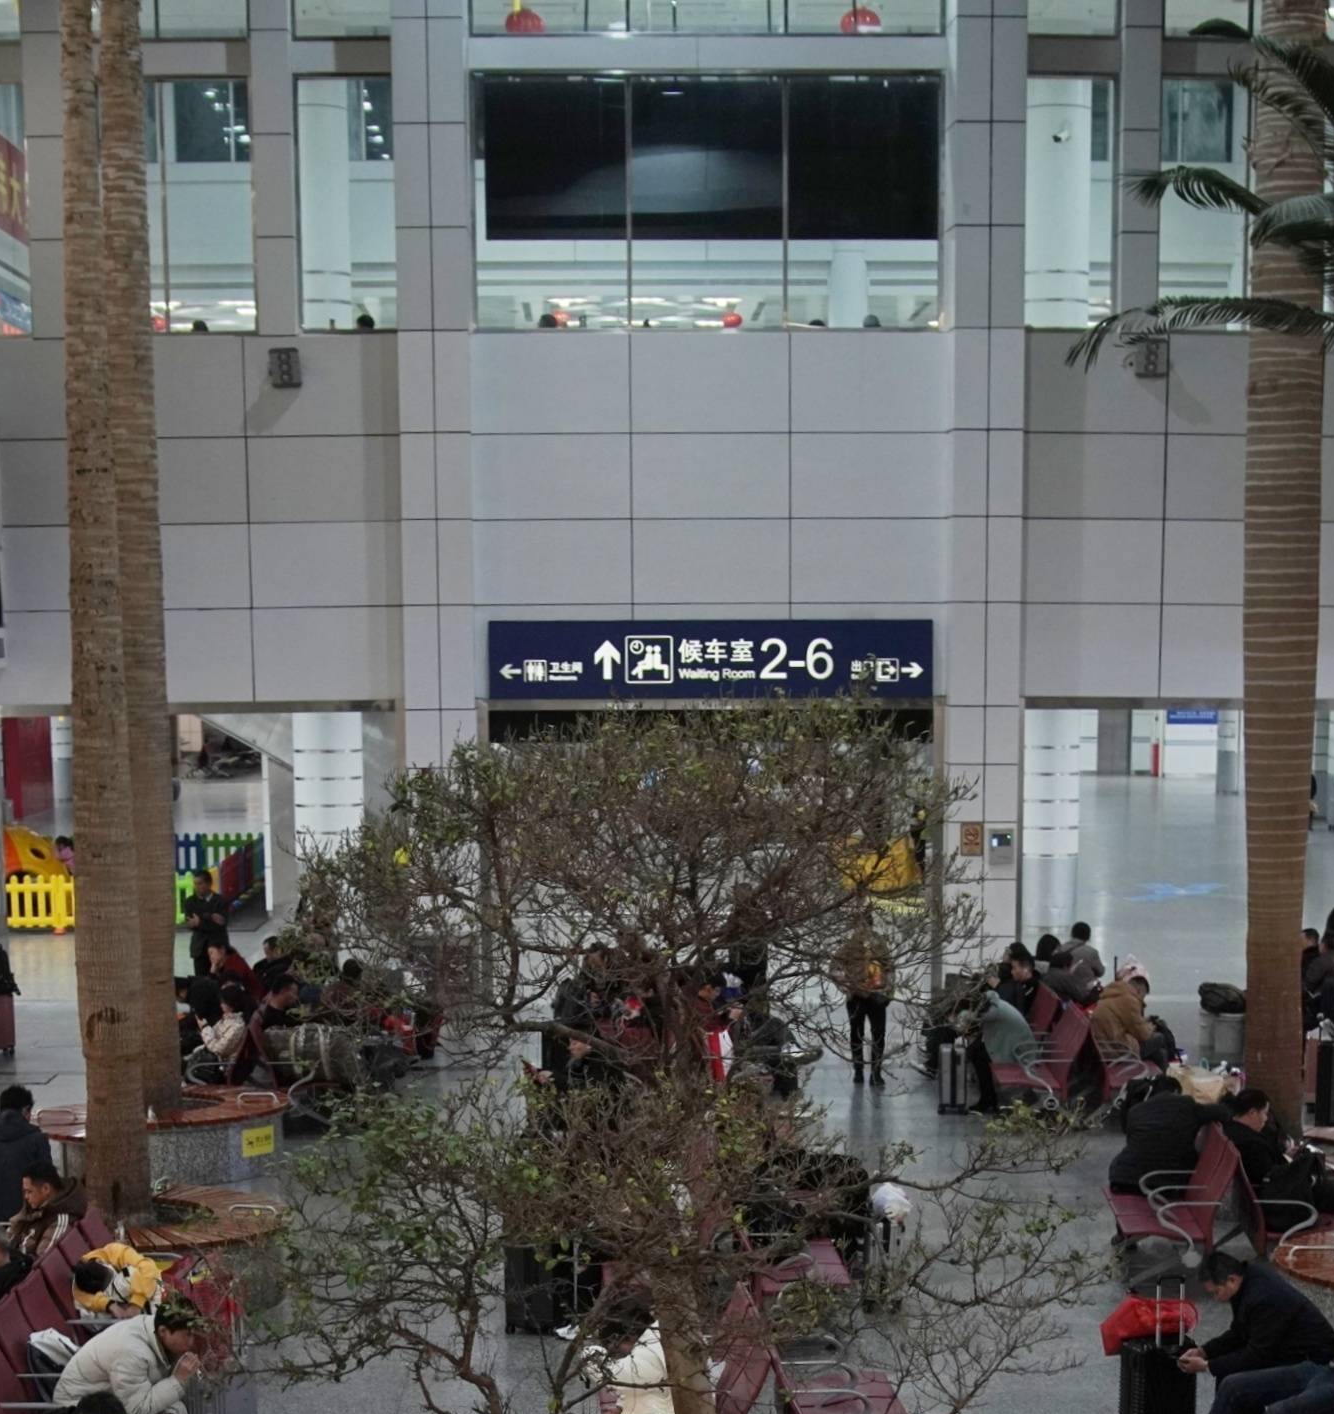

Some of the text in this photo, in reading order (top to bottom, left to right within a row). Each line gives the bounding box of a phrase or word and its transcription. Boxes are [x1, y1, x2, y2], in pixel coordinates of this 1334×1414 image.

[678, 638, 754, 664] 候车室
[759, 637, 834, 680] 2-6
[549, 661, 583, 674] 卫生间
[678, 668, 755, 681] Waiting Room
